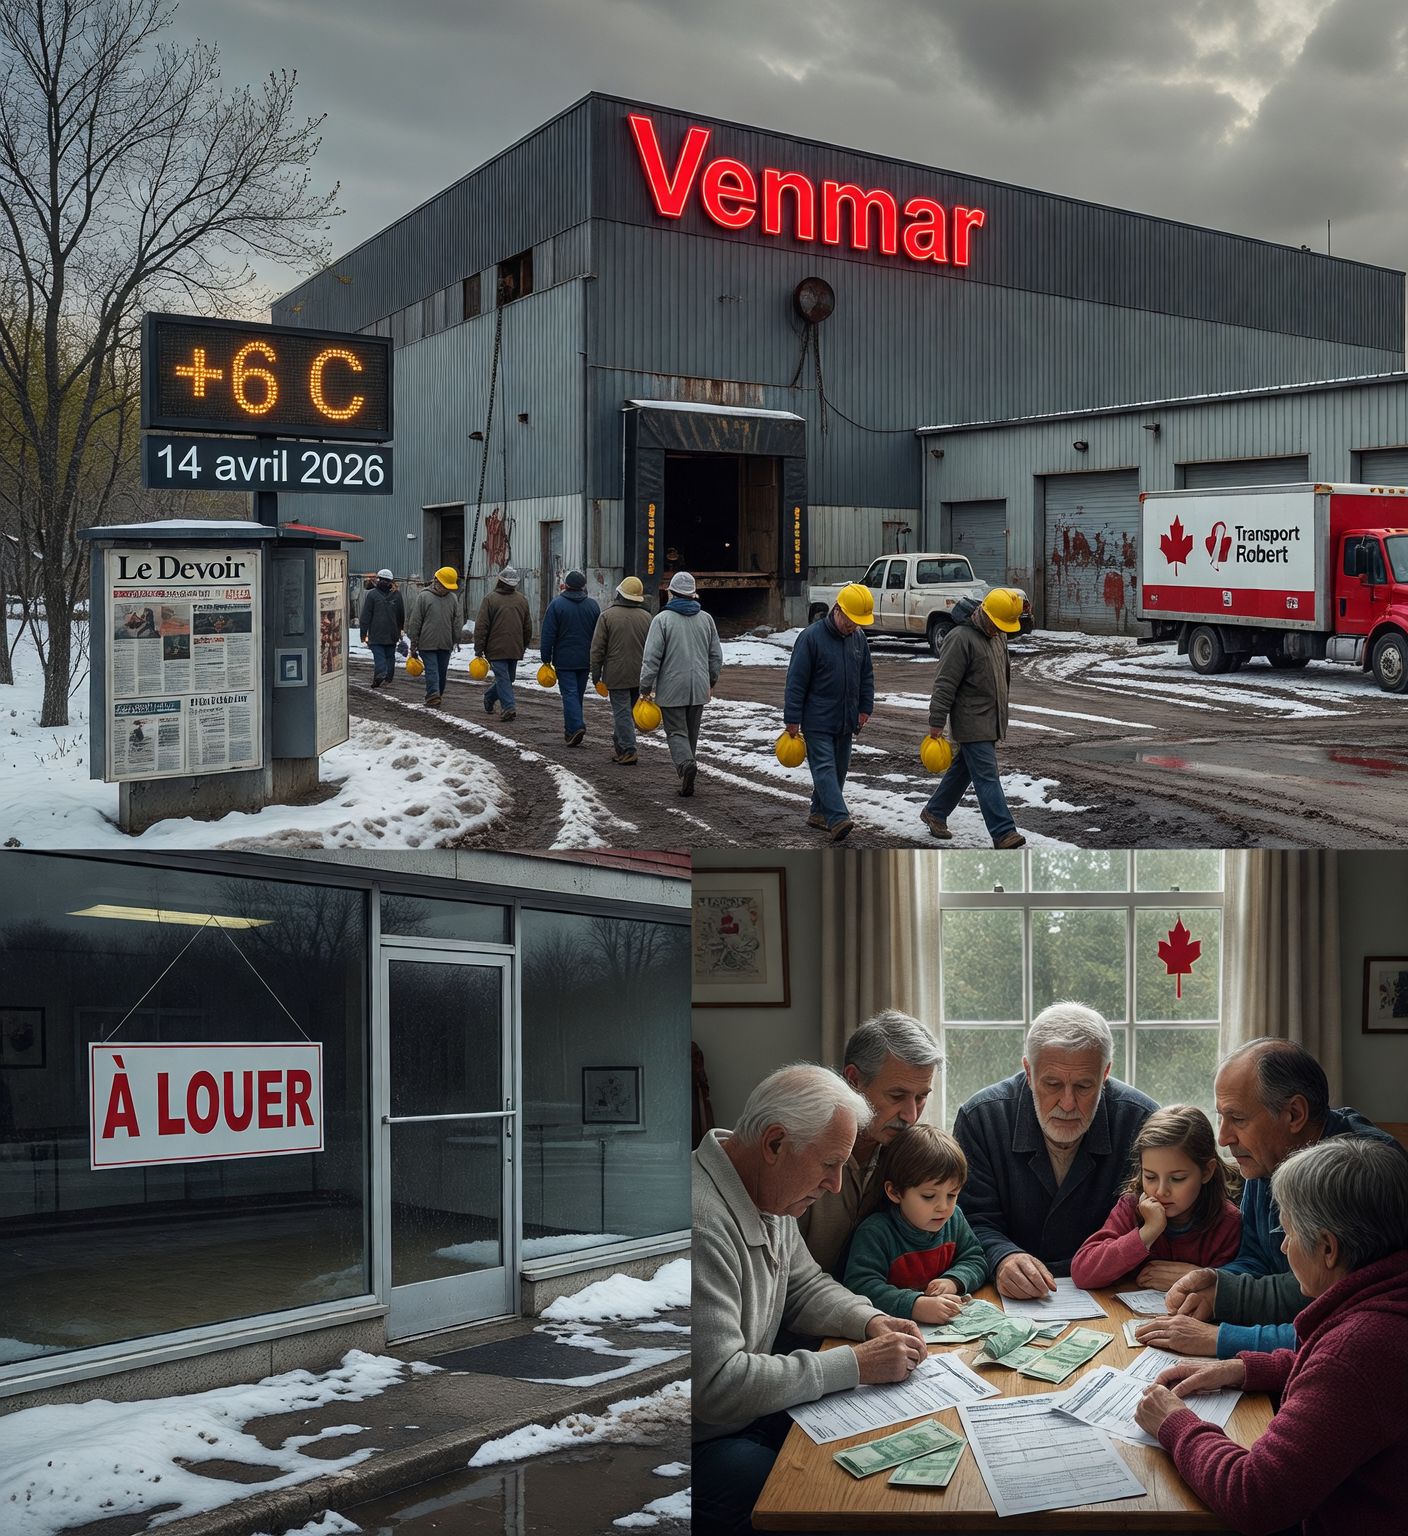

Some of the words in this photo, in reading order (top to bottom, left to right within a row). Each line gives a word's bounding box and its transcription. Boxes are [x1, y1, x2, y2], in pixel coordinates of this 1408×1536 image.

[627, 112, 986, 267] Venmar
[175, 341, 279, 415] +6
[309, 349, 365, 420] C
[157, 444, 202, 479] 14
[215, 449, 288, 482] avril
[300, 450, 385, 486] 2026
[1234, 525, 1301, 543] Transport
[1236, 544, 1289, 564] Robert
[117, 556, 153, 580] Le
[156, 555, 246, 580] Devoir
[102, 1055, 140, 1139] À
[157, 1069, 315, 1136] LOUER
